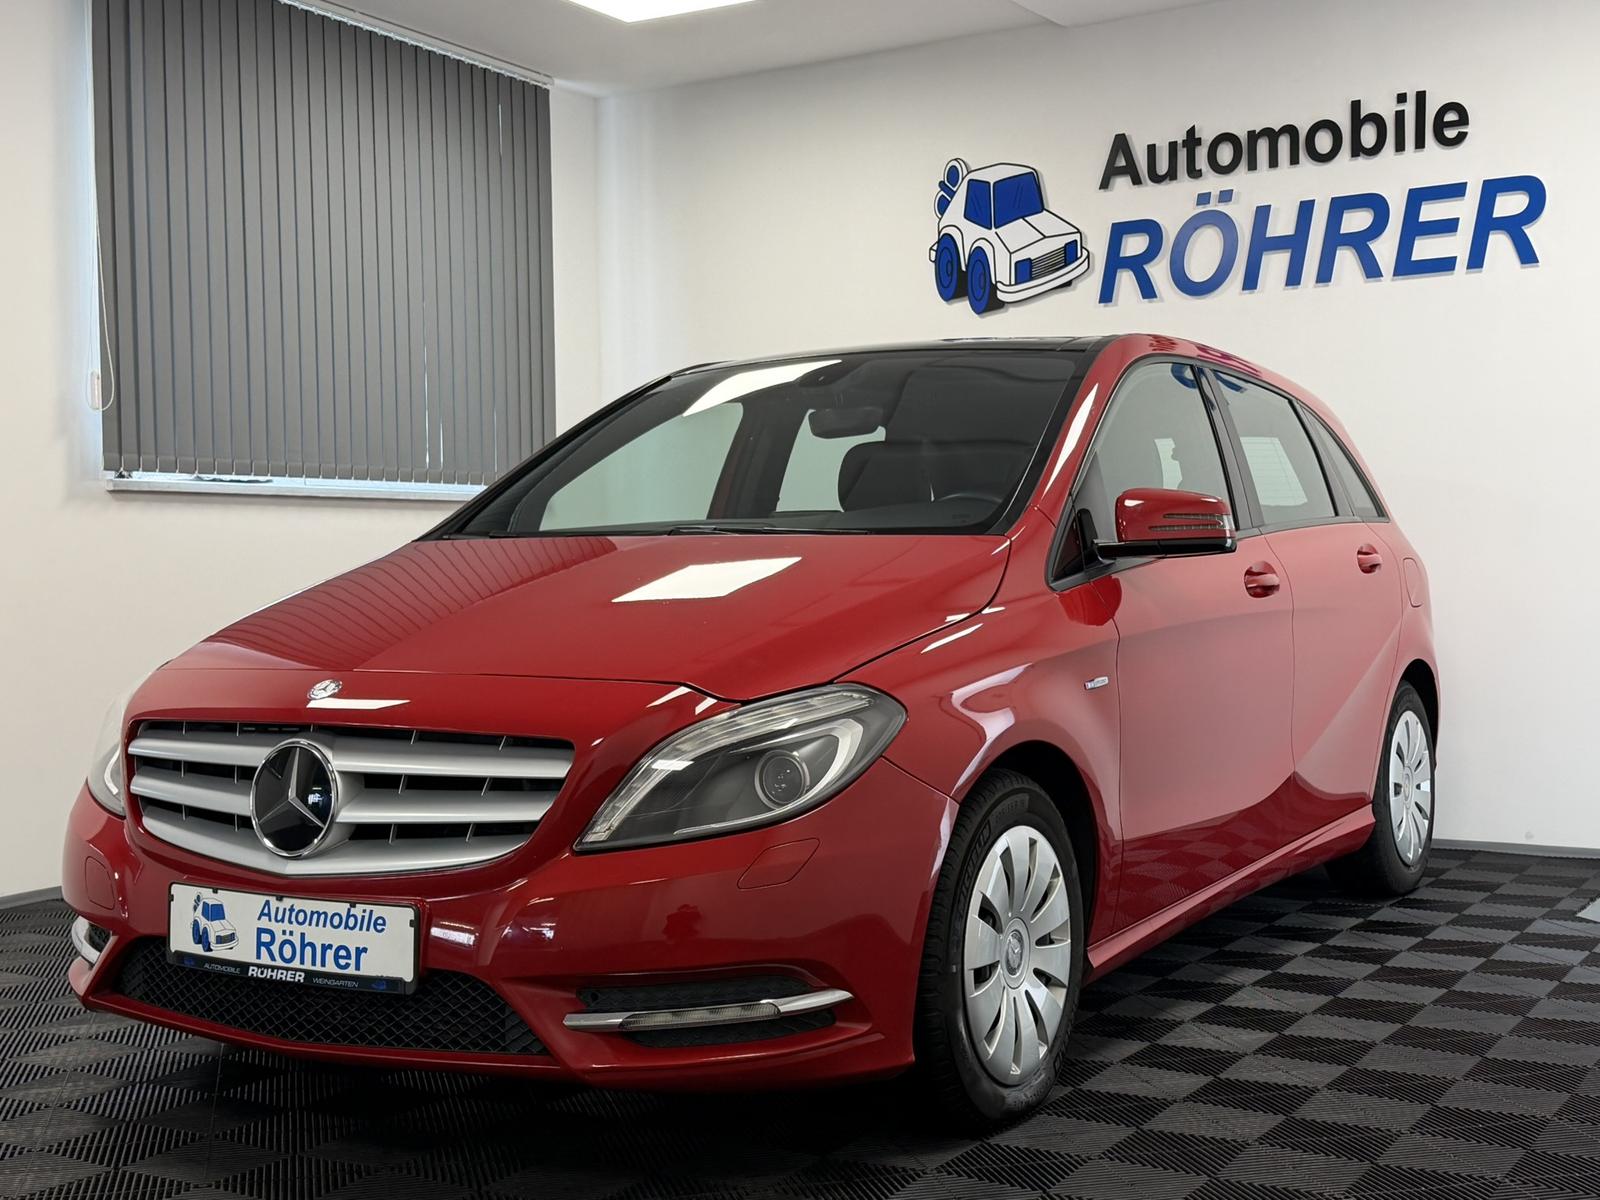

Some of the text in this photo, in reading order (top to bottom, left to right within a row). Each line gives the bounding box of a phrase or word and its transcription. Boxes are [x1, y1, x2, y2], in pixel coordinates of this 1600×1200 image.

[1098, 90, 1470, 190] Automobile
[1098, 175, 1547, 304] RÖHRER
[257, 899, 387, 934] Automobile
[255, 926, 368, 972] Röhrer
[203, 962, 359, 988] AUTOMOBILE RÖHRER WEINGARTEN
